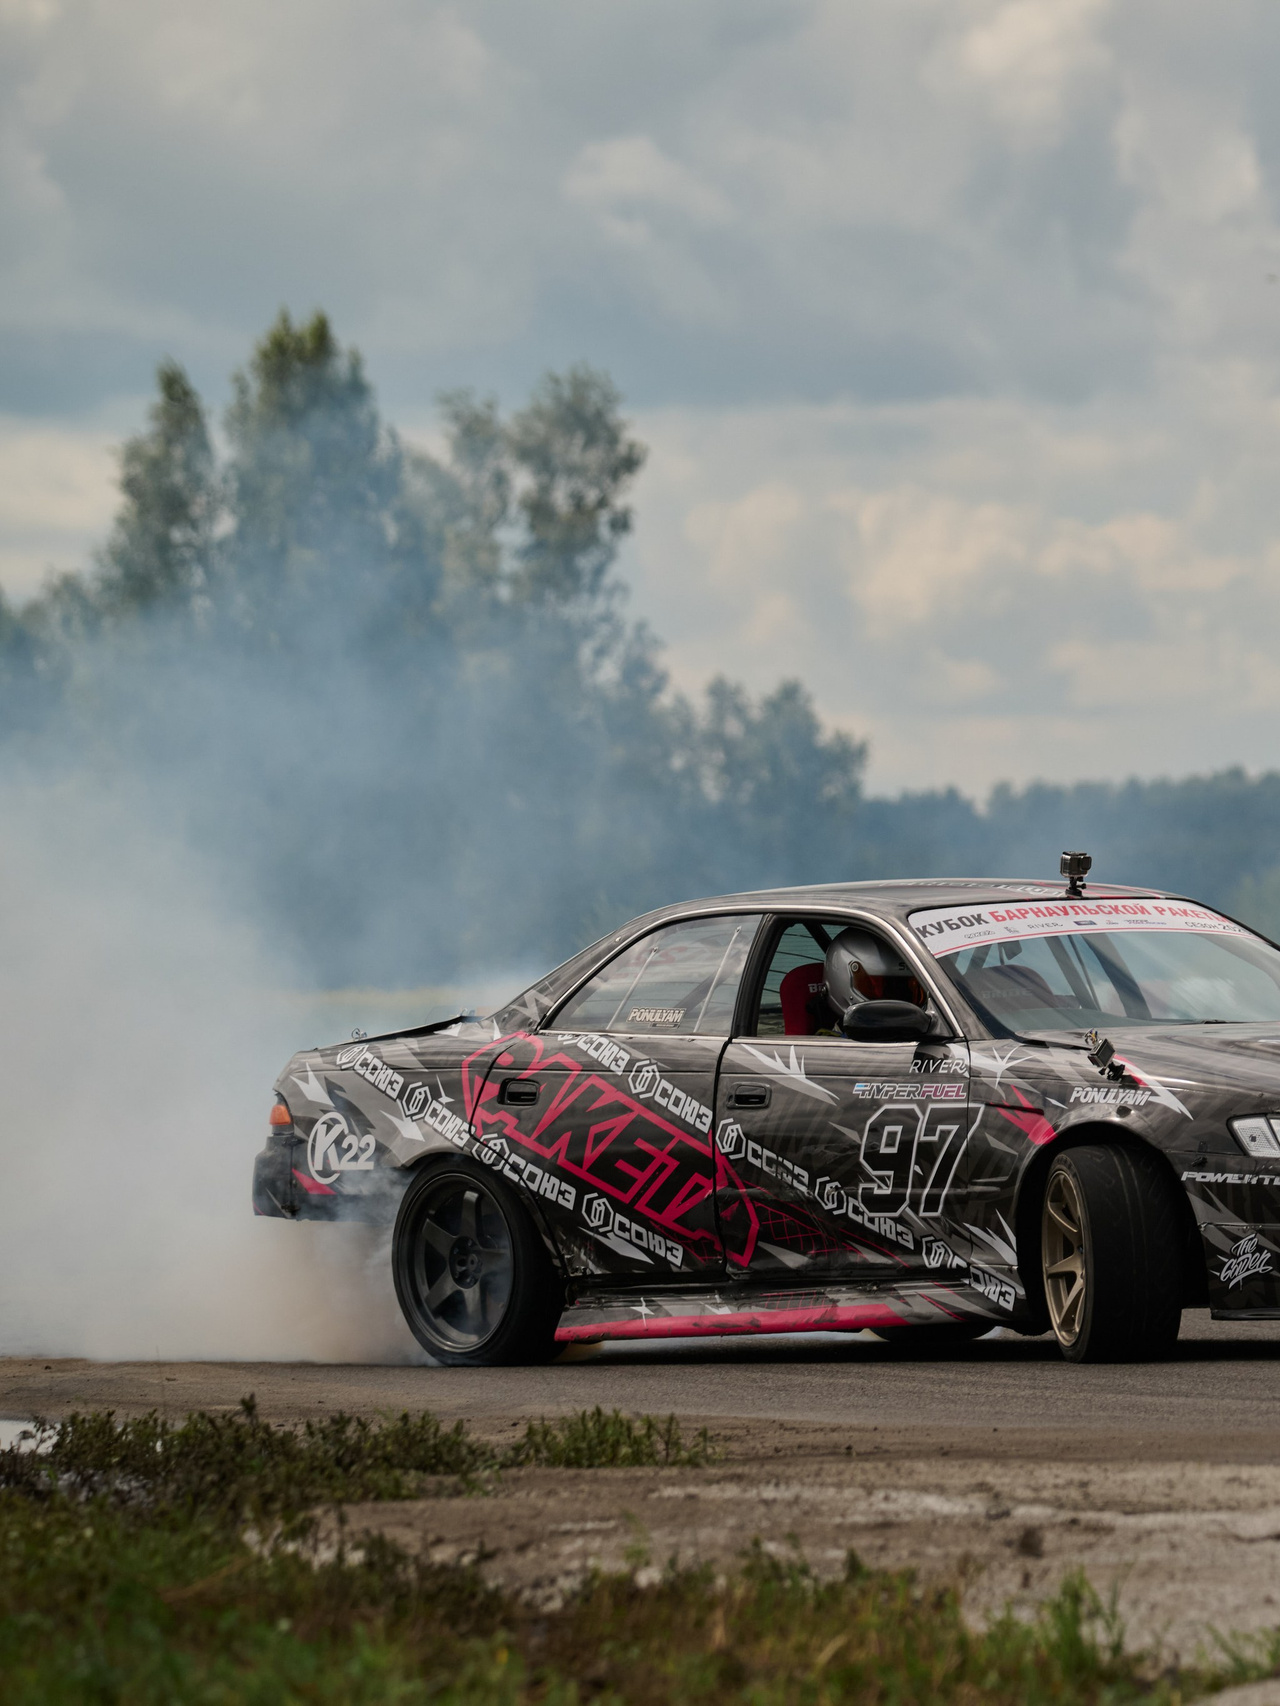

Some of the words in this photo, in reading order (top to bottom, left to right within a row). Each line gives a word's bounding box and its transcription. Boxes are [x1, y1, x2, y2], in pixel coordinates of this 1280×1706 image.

[915, 913, 989, 938] КУБОК
[988, 902, 1152, 923] БАРНАУЛЬСКОЙ
[909, 1059, 967, 1074] RIVER
[1069, 1086, 1152, 1106] PONULYAM
[857, 1103, 985, 1217] 97
